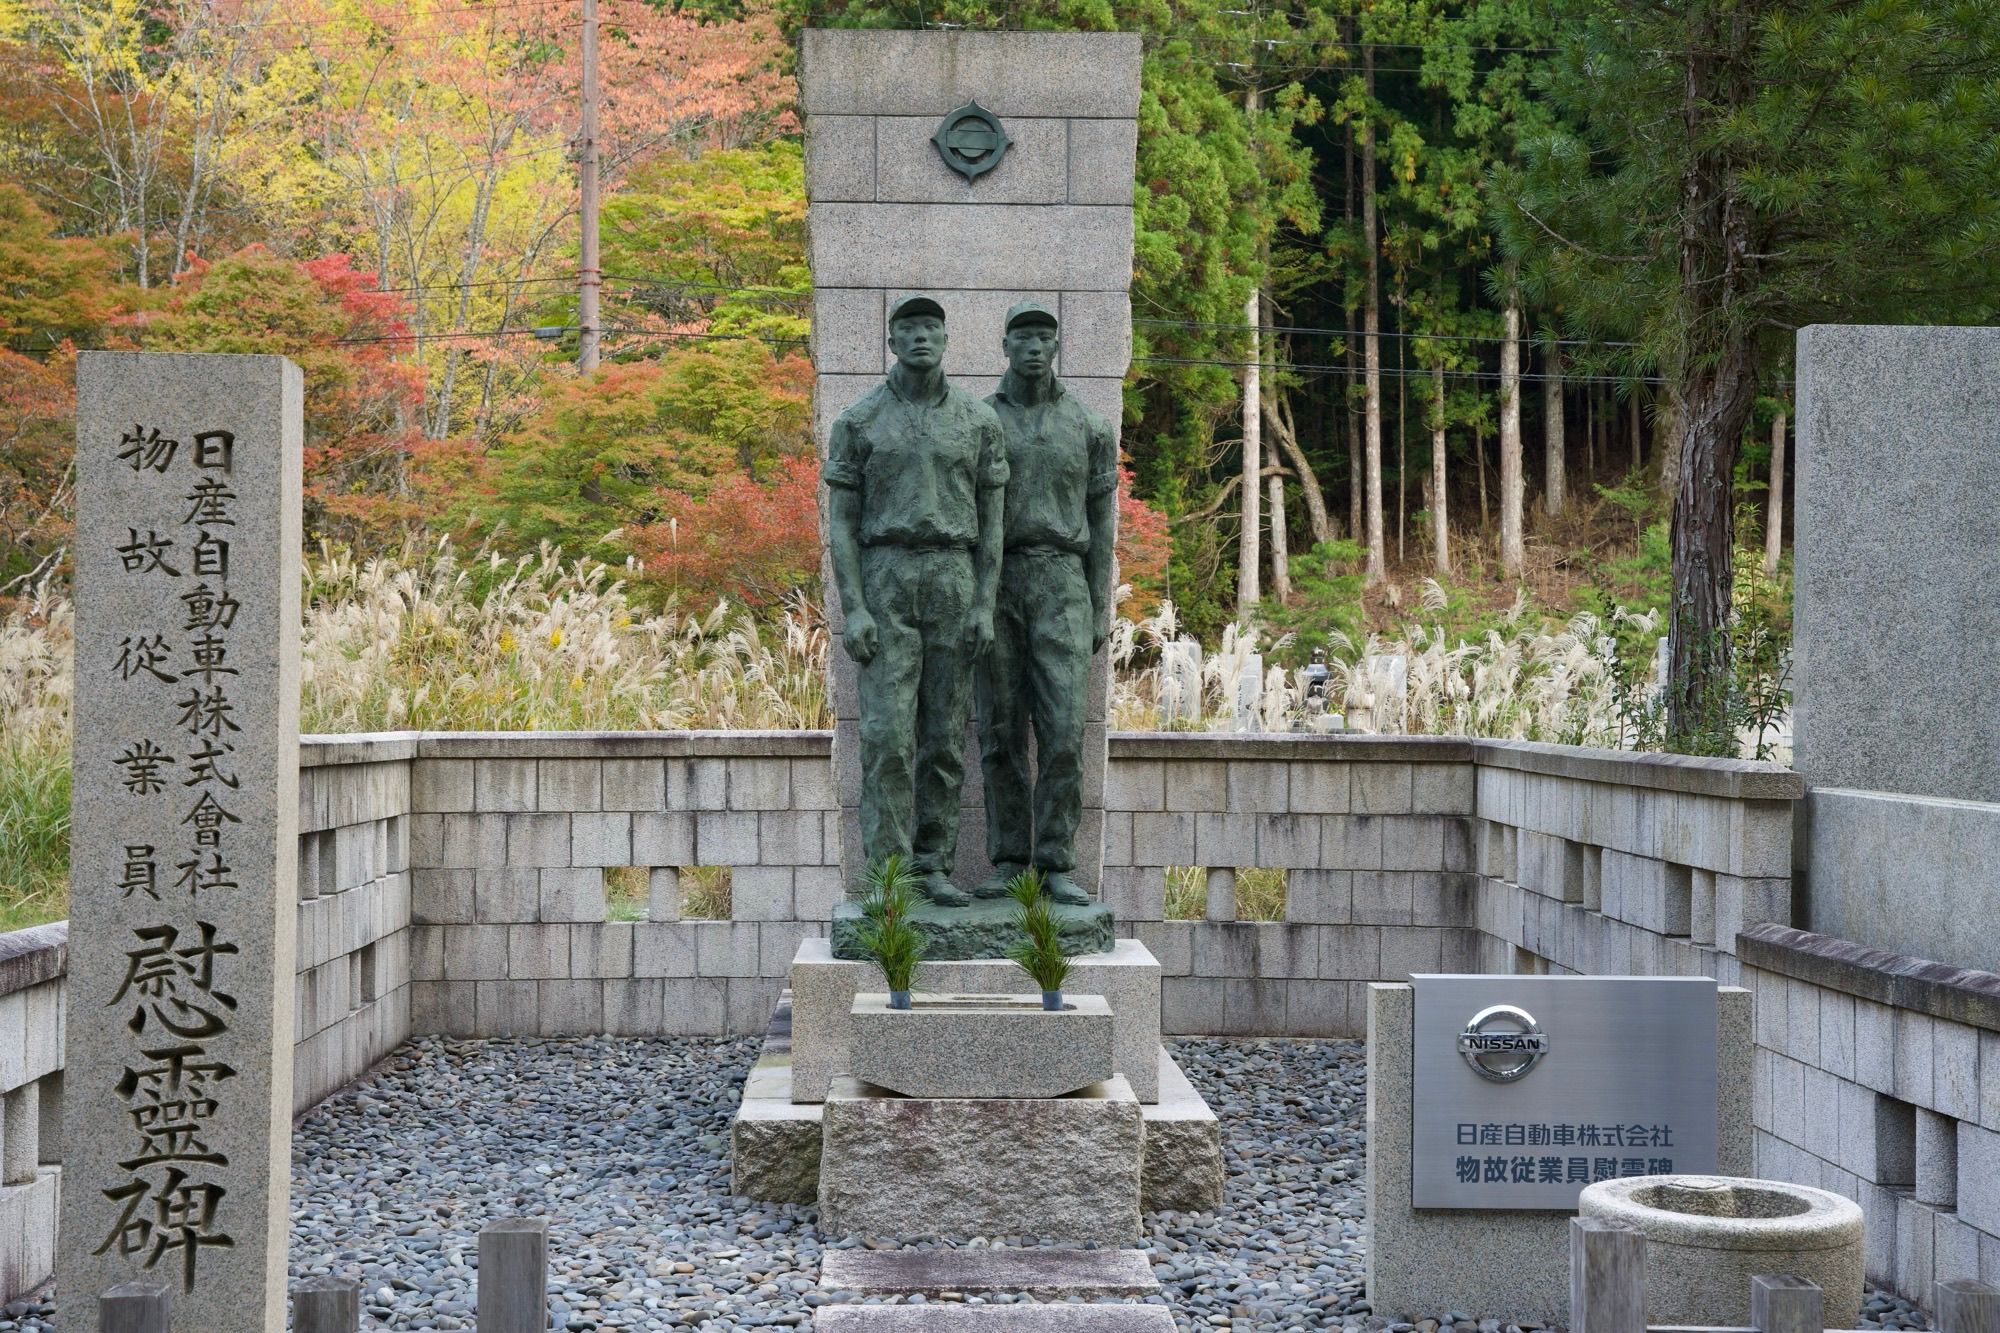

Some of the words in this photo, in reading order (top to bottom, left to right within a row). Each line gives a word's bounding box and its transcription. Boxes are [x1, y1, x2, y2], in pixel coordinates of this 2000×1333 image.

[1469, 1038, 1540, 1050] NISSAN
[1456, 1123, 1674, 1147] 日産自動車株式会社
